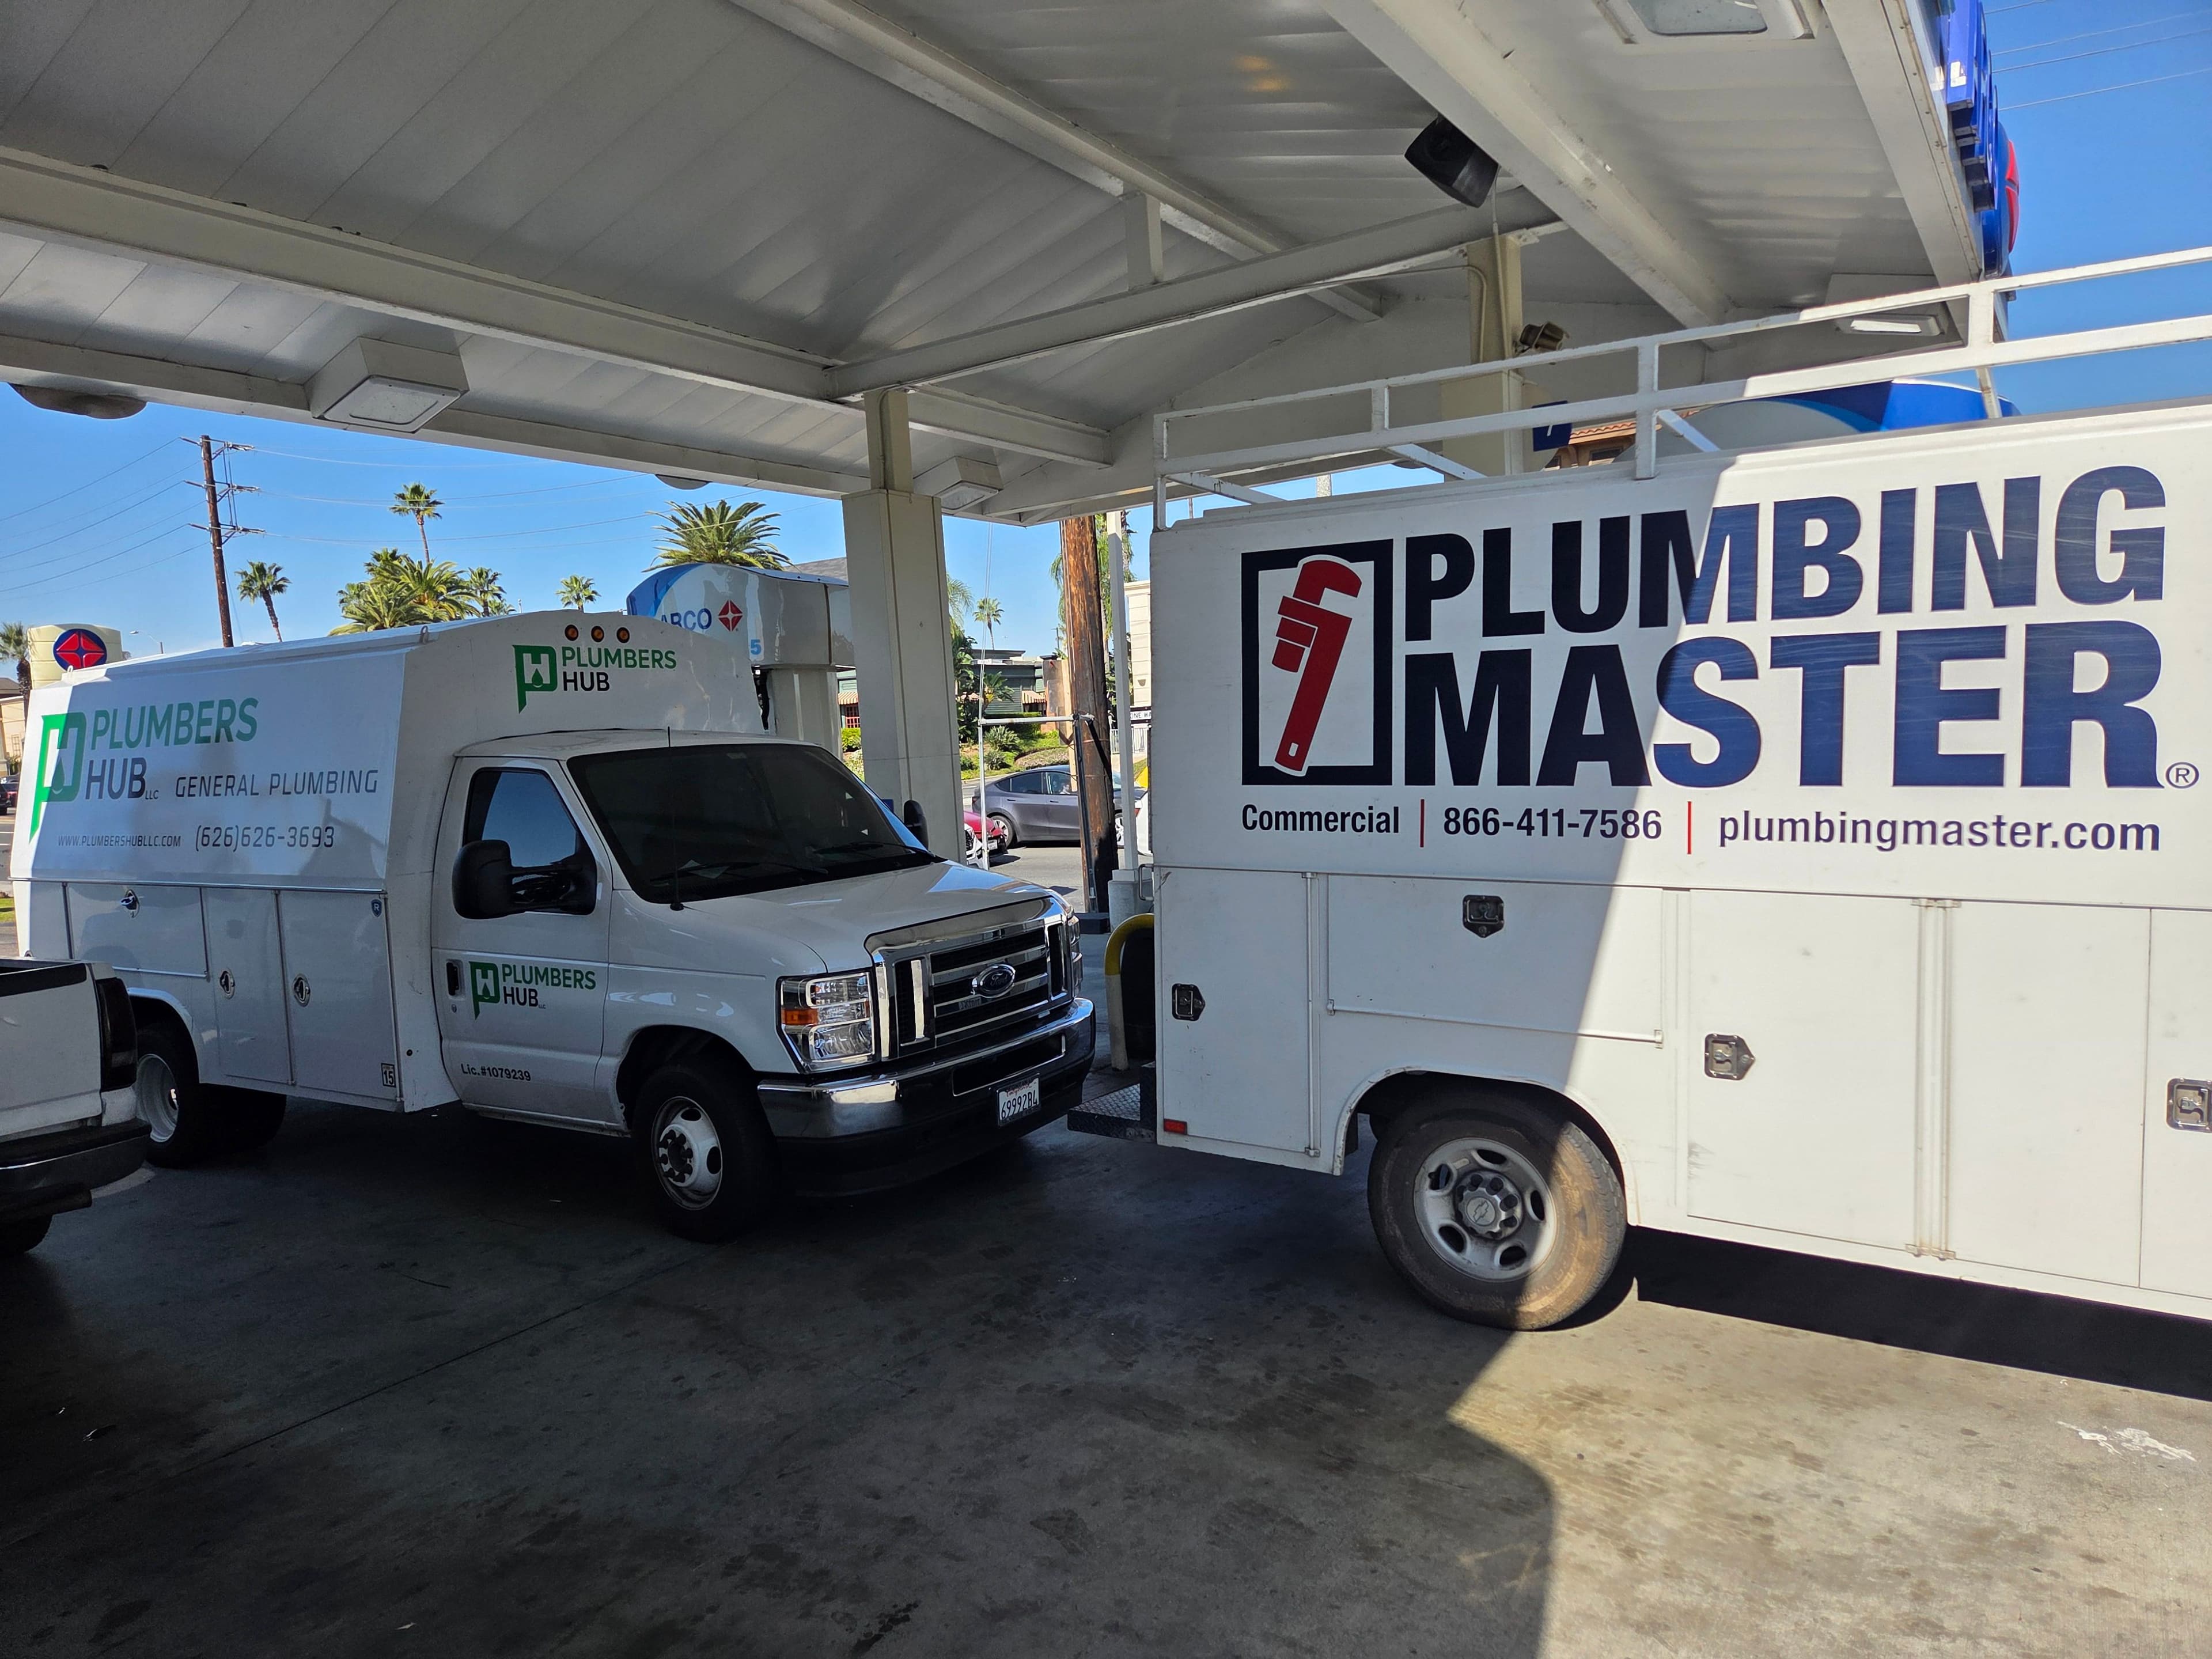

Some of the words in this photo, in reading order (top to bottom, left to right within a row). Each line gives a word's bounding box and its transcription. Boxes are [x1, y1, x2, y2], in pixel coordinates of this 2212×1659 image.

[1405, 465, 2166, 641] PLUMBING
[562, 646, 677, 669] PLUMBERS
[750, 639, 762, 656] 5
[562, 671, 611, 692] HUB
[90, 697, 260, 750] PLUMBERS
[85, 757, 147, 800] HUB
[145, 789, 159, 800] LLC
[175, 774, 260, 797] GENERAL
[268, 769, 378, 796] PLUMBING
[58, 834, 181, 847] WWW.PLUMBERSHUBLLC.COM
[195, 824, 335, 853] (626)626-3693
[1241, 803, 1400, 834] Commercial
[1443, 807, 1662, 840] 866-411-7586
[1718, 810, 2160, 853] plumbingmaster.com
[502, 963, 597, 990] PLUMBERS
[503, 986, 539, 1007] HUB
[383, 1070, 394, 1085] 15
[460, 1063, 531, 1081] Lic.#1079239
[1001, 1089, 1038, 1120] 69992B4
